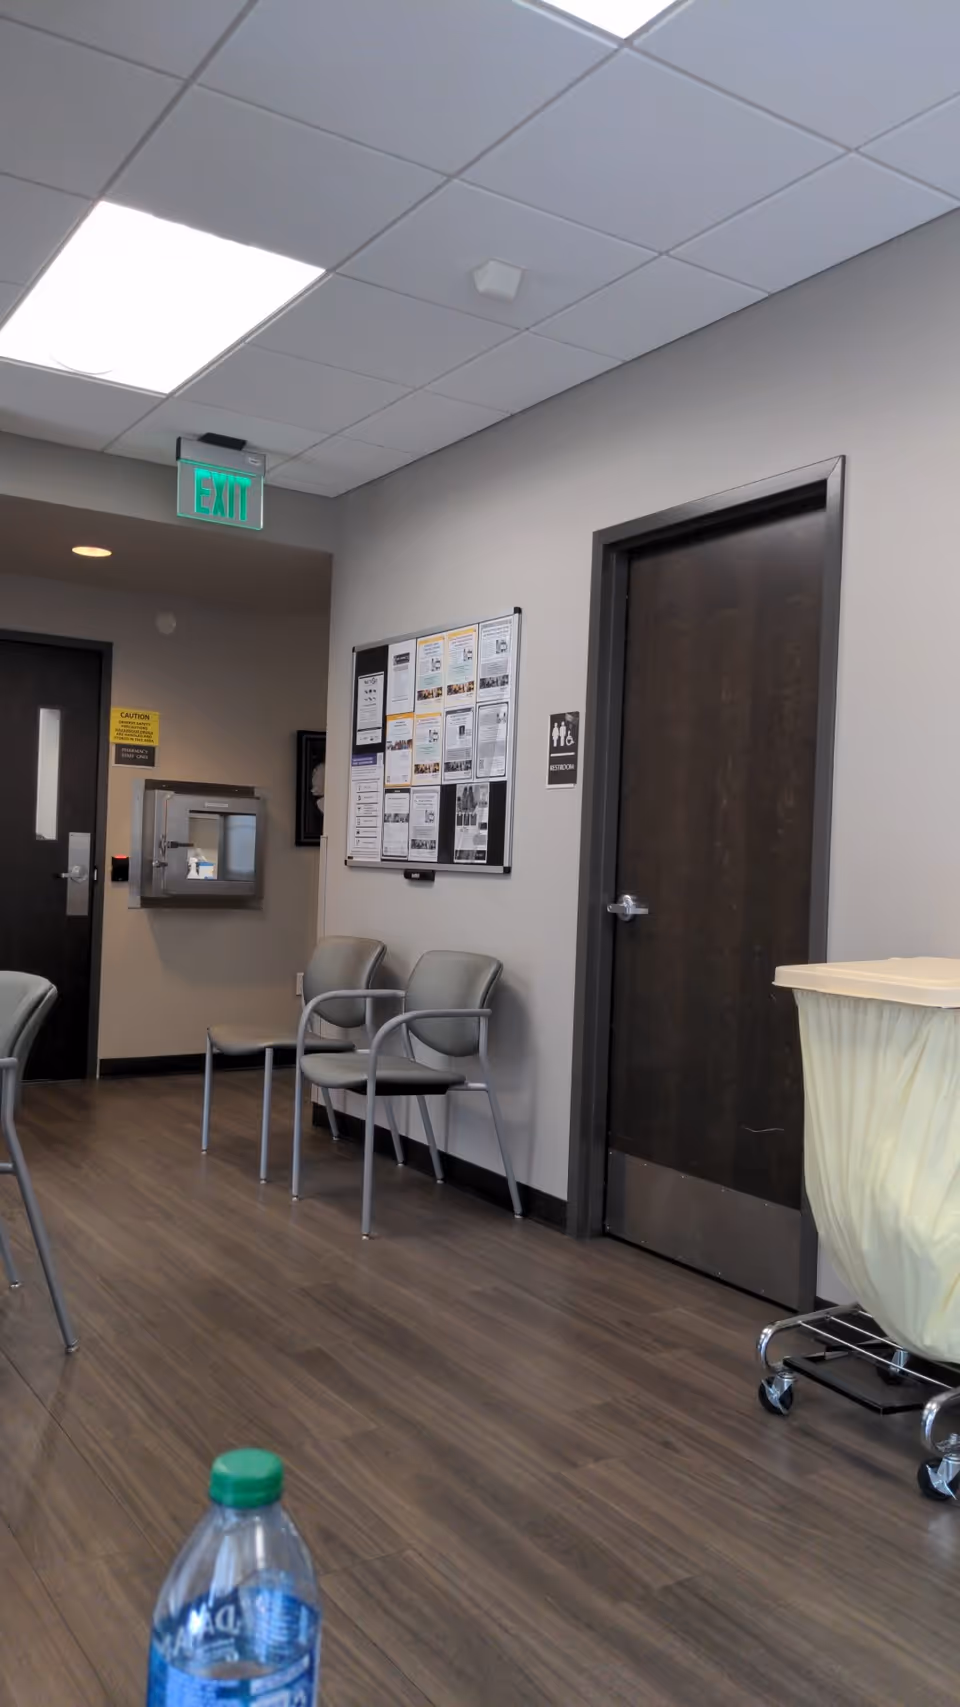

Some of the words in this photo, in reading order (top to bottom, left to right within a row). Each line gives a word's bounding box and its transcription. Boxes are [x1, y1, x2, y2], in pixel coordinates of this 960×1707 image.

[194, 467, 252, 523] EXIT
[120, 712, 150, 720] CAUTION
[549, 763, 575, 772] RESTROOM
